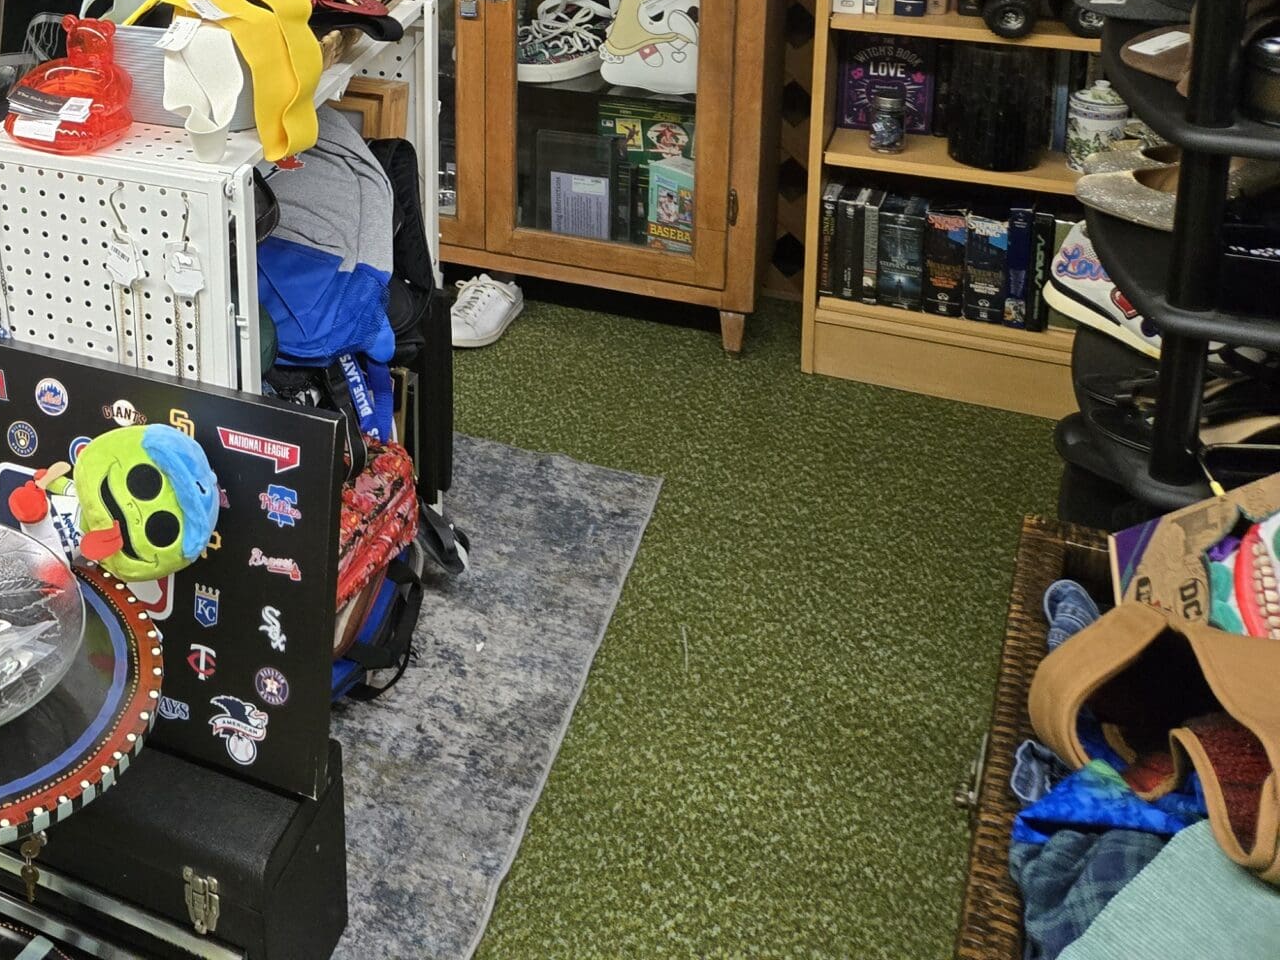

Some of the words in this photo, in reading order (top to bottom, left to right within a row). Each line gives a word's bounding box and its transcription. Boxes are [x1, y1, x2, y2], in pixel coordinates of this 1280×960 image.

[855, 45, 894, 63] WITCH'S
[895, 47, 923, 67] BOOK
[869, 61, 907, 78] LOVE
[975, 227, 1001, 238] KING
[339, 353, 363, 384] JAYS
[352, 384, 374, 417] BLUE
[102, 404, 147, 425] GIANTS
[228, 433, 262, 454] NATIONAL
[264, 441, 290, 459] LEAGUE
[259, 492, 302, 520] Phillies
[248, 547, 296, 570] Braves
[197, 598, 216, 622] KC
[1179, 578, 1203, 620] DC
[258, 606, 287, 653] Sox
[159, 696, 190, 721] AYS
[221, 719, 259, 736] AMERICAN
